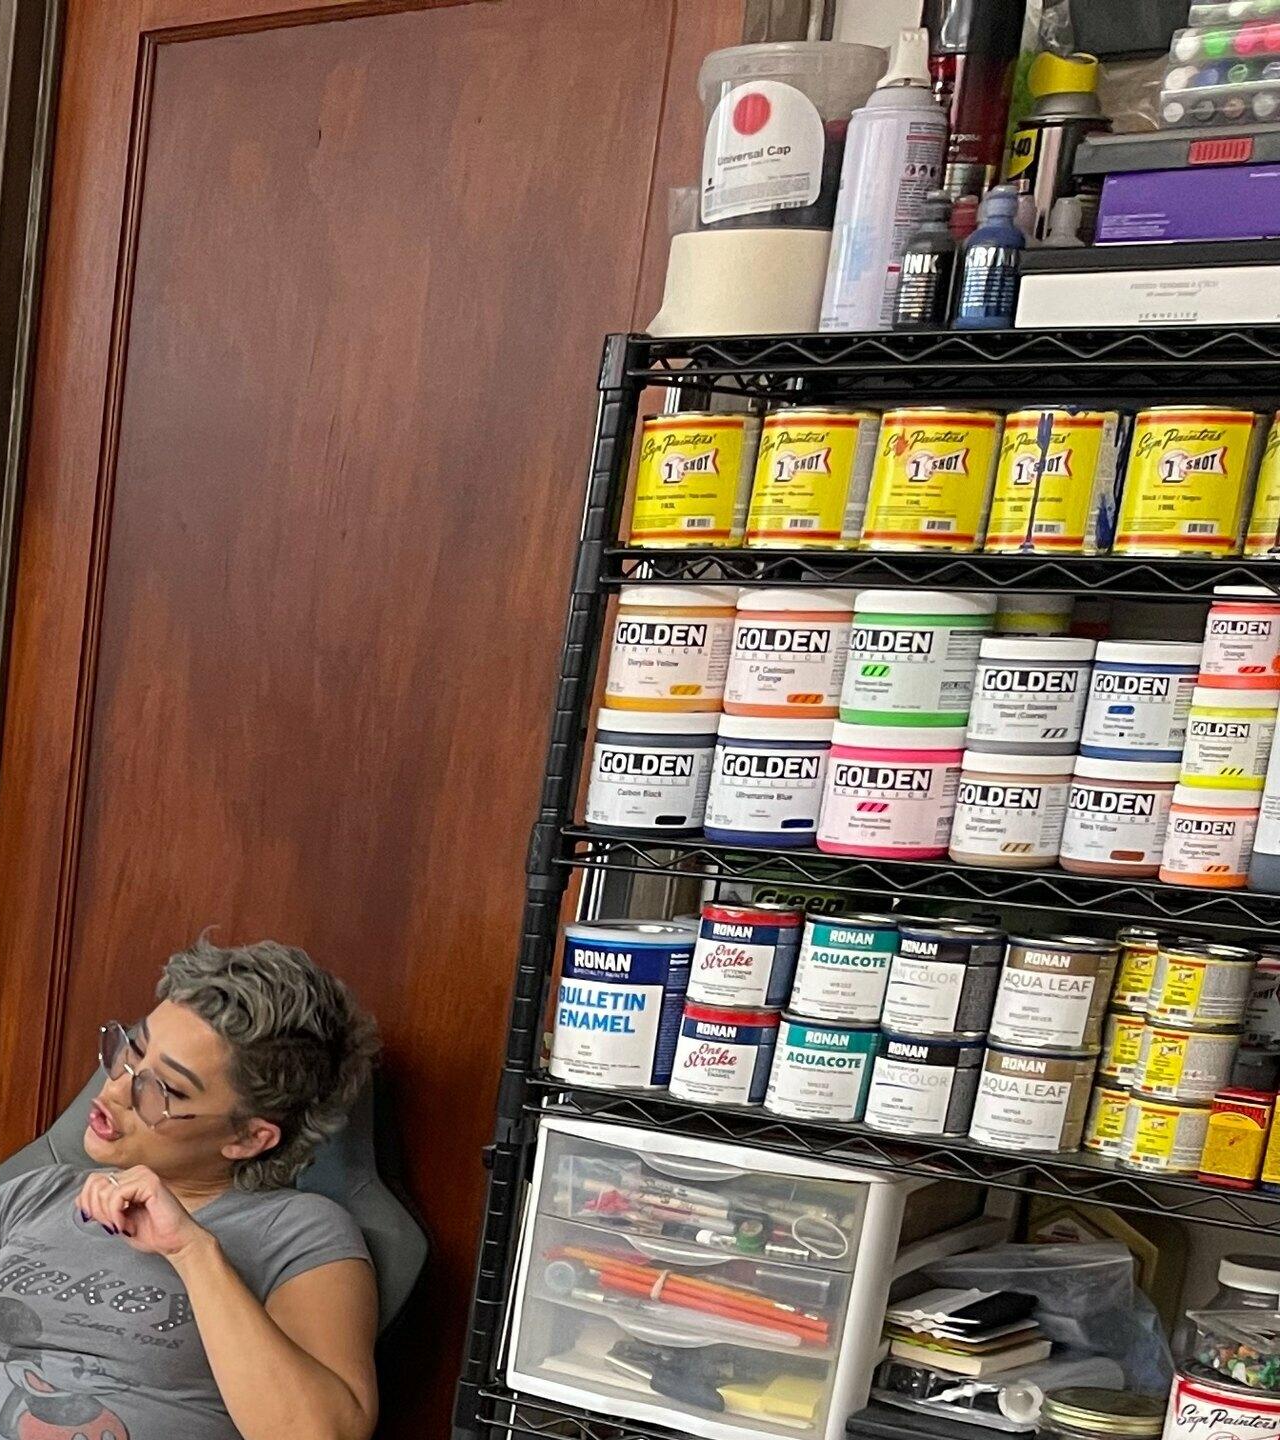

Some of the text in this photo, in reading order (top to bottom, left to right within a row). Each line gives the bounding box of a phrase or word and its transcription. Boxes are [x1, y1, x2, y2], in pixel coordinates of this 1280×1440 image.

[718, 148, 763, 166] Universal
[767, 144, 791, 157] Cap
[683, 455, 710, 471] SHOT
[794, 454, 821, 470] SHOT
[932, 454, 959, 471] SHOT
[1033, 456, 1061, 473] SOT
[1186, 453, 1217, 470] SHOT
[617, 622, 704, 646] GOLDEN
[1212, 620, 1271, 635] GOLDEN
[737, 628, 828, 652] GOLDEN
[850, 630, 932, 653] GOLDEN
[985, 670, 1077, 692] GOLDEN
[1095, 675, 1168, 696] GOLDEN
[1191, 721, 1250, 738] GOLDEN
[600, 752, 692, 776] GOLDEN
[723, 754, 818, 779] GOLDEN
[835, 765, 930, 790] GOLDEN
[958, 784, 1039, 809] GOLDEN
[1069, 788, 1153, 815] GOLDEN
[1175, 819, 1235, 836] GOLDEN
[713, 923, 753, 939] RONAN
[829, 930, 874, 945] RONAN
[715, 944, 738, 957] One
[901, 938, 938, 956] RONAN
[574, 949, 632, 972] RONAN
[700, 952, 754, 970] Stroke
[810, 951, 887, 968] AQUACOTE
[1024, 951, 1071, 969] RONAN
[908, 968, 959, 985] COLOR
[1005, 973, 1091, 992] AQUA LEAF
[559, 985, 646, 1012] BULLETIN
[559, 1008, 636, 1033] ENAMEL
[697, 1022, 737, 1038] RONAN
[805, 1031, 850, 1047] RONAN
[699, 1043, 722, 1055] One
[888, 1042, 929, 1059] RONAN
[684, 1051, 737, 1068] Stroke
[786, 1052, 862, 1069] AQUACOTE
[1001, 1056, 1047, 1074] RONAN
[899, 1069, 949, 1086] COLOR
[982, 1077, 1068, 1099] AQUA LEAF
[1177, 1403, 1209, 1433] Sign
